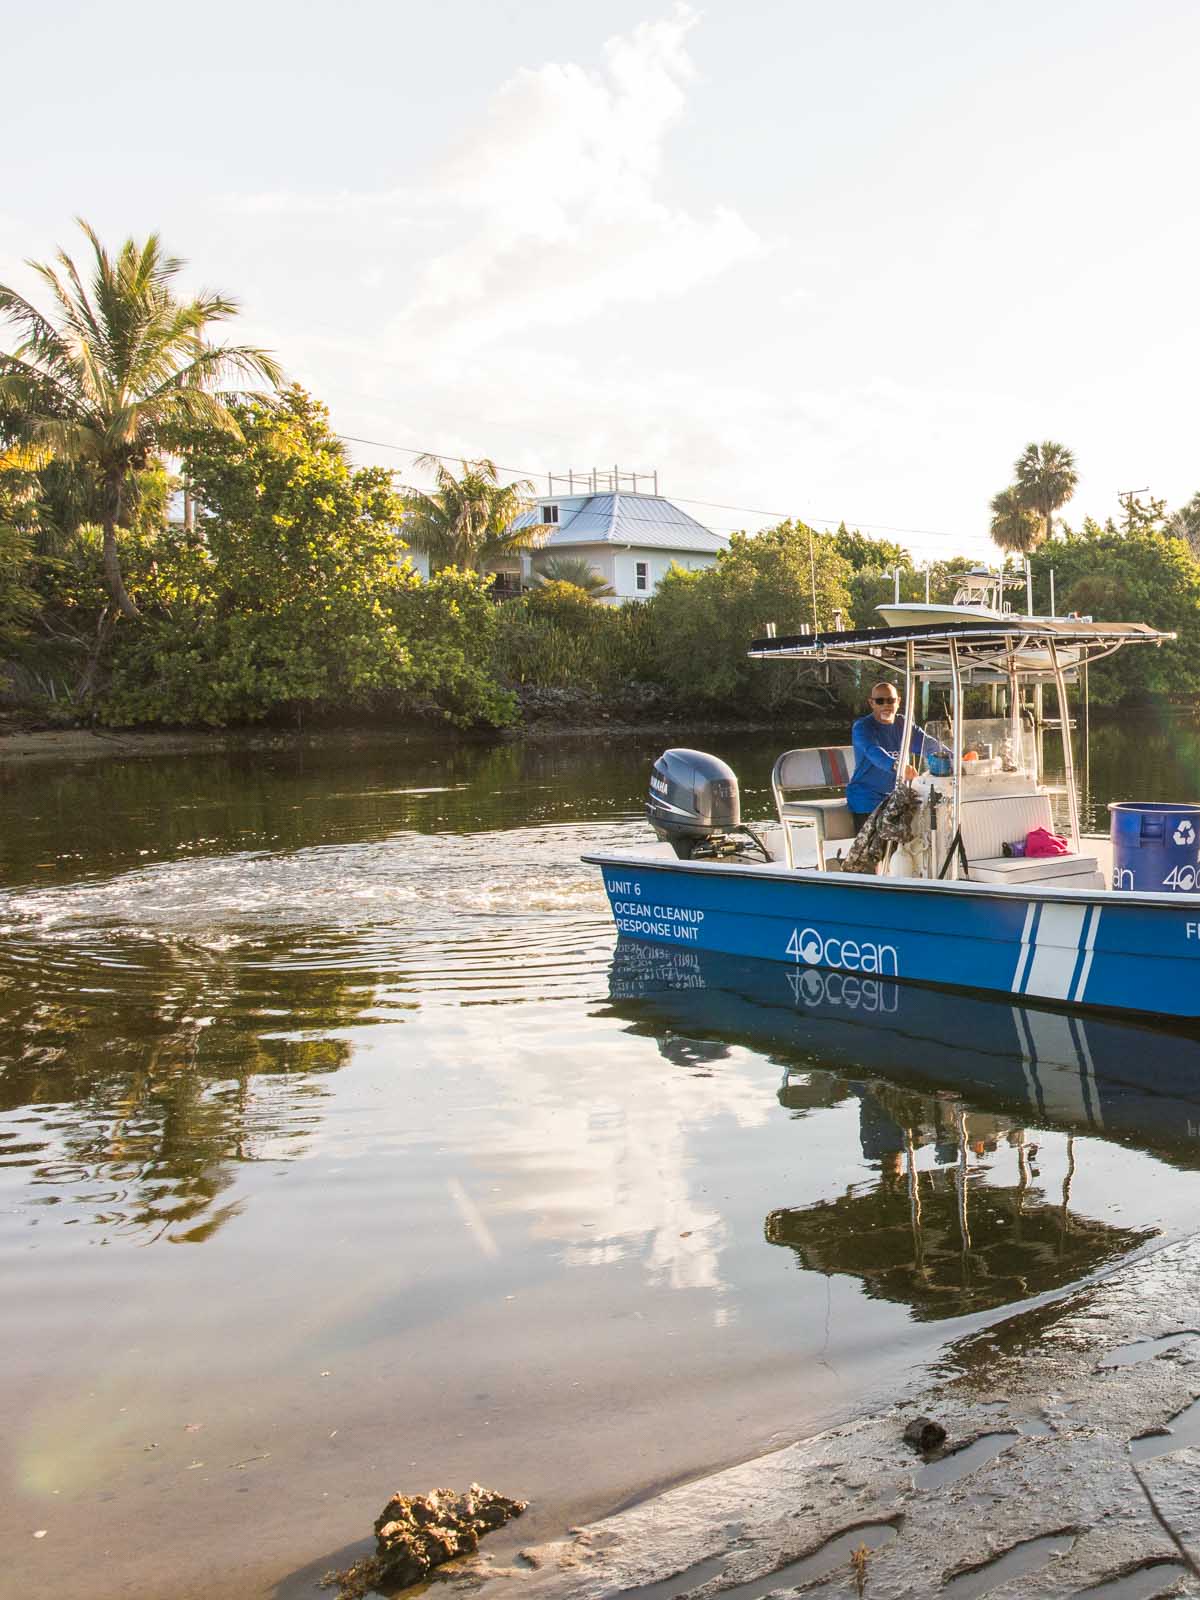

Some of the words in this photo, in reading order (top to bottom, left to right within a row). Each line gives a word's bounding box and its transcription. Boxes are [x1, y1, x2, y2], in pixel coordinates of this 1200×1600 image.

[608, 881, 631, 895] UNIT
[634, 883, 641, 896] 6
[615, 902, 651, 917] OCEAN
[653, 906, 704, 924] CLEANUP
[617, 919, 671, 937] RESPONSE
[673, 927, 699, 940] UNIT
